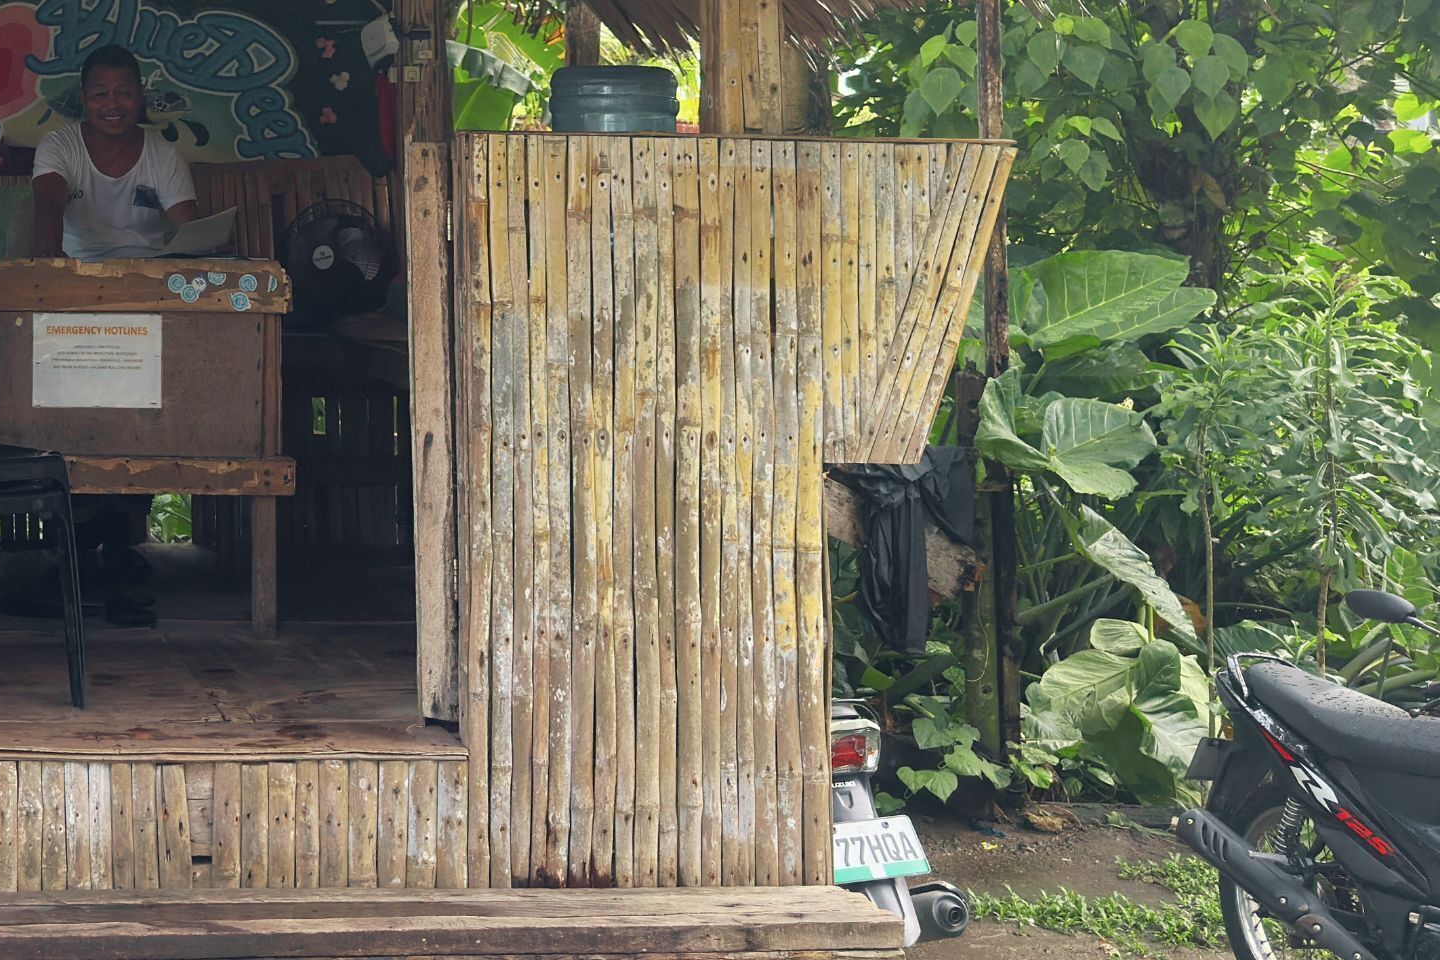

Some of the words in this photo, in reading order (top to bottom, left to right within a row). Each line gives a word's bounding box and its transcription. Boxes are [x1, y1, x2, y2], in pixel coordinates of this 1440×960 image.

[46, 325, 102, 335] EMERGENCY
[104, 326, 148, 336] HOTLINES
[832, 780, 856, 789] UZUKI
[1334, 807, 1395, 857] 125
[835, 831, 920, 867] 77HQA
